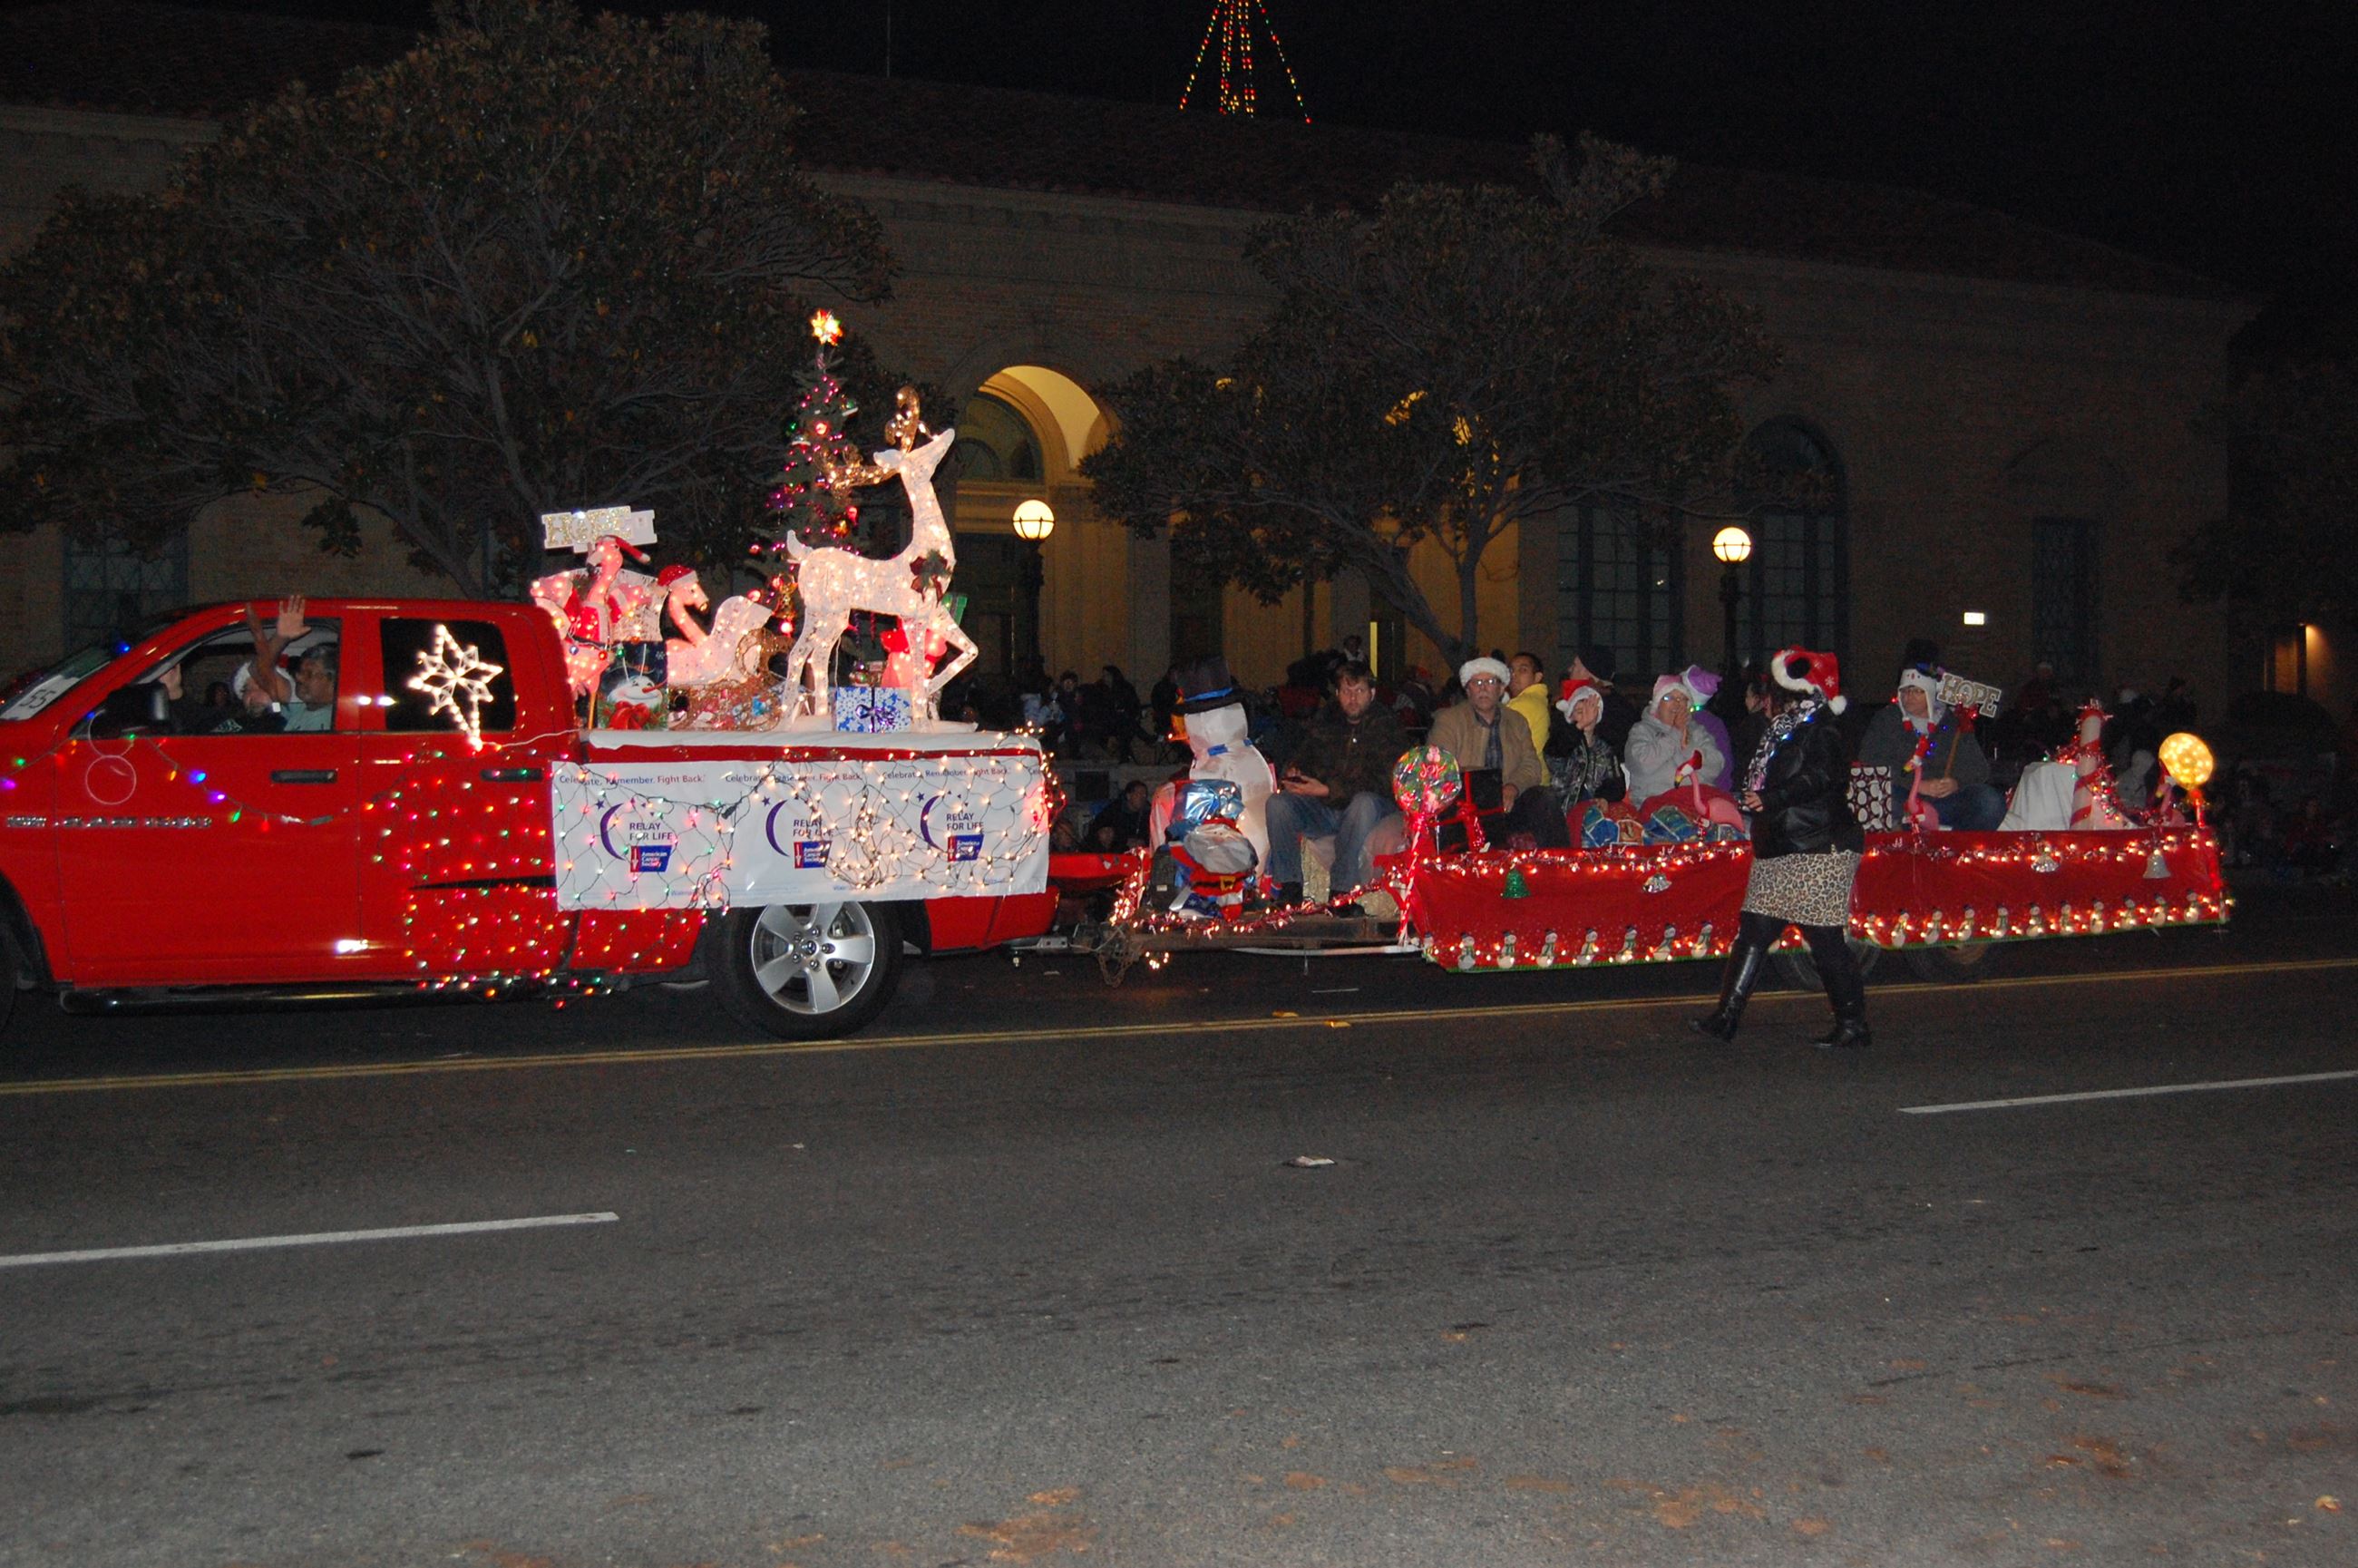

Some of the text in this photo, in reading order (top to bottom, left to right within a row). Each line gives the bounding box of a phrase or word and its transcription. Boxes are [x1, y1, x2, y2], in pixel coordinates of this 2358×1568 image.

[18, 689, 56, 709] 55
[1937, 672, 2002, 717] HOPE
[1419, 762, 1447, 779] JOY
[946, 813, 974, 821] RELAY
[629, 822, 661, 831] RELAY
[947, 823, 964, 831] FOR
[652, 832, 673, 841] LIFE
